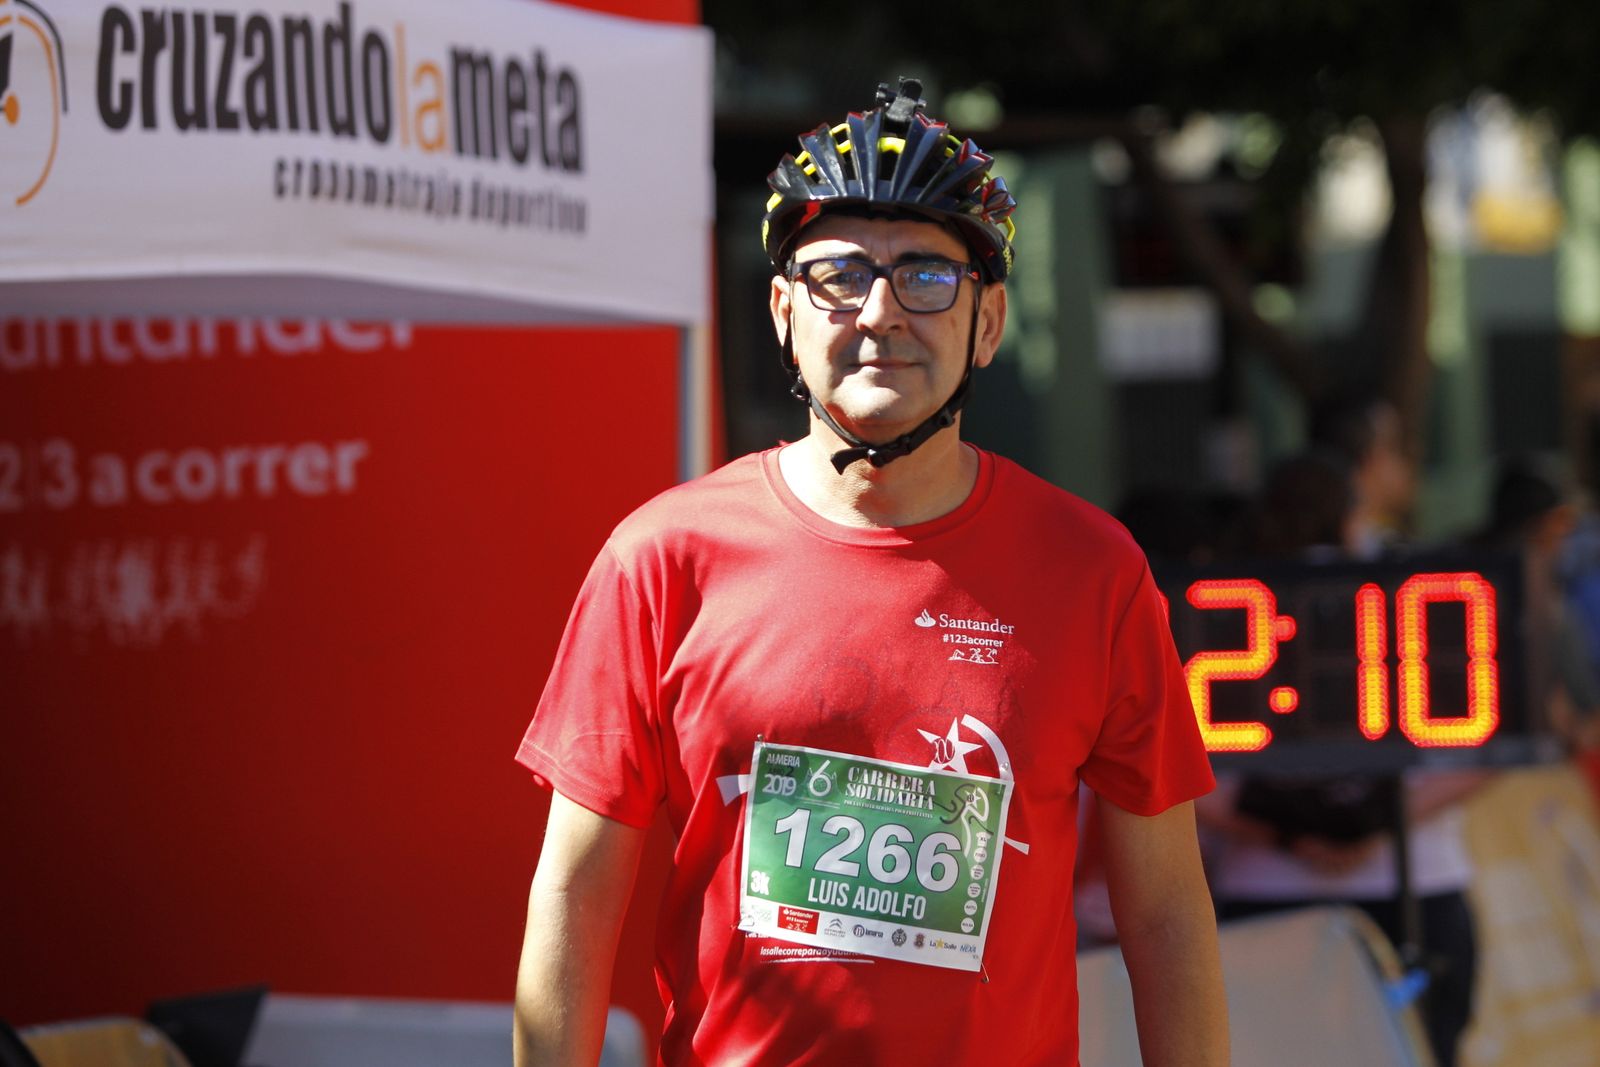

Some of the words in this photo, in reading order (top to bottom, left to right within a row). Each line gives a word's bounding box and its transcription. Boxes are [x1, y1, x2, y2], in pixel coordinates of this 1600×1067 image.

[136, 440, 366, 502] correr
[939, 613, 1015, 635] Santander
[942, 634, 1004, 648] #123acorrer
[1160, 572, 1498, 751] 2:10
[762, 773, 797, 796] 2019
[848, 766, 936, 796] CARRERA
[845, 783, 933, 810] SOLIDARIA
[775, 808, 962, 893] 1266
[807, 877, 850, 908] LUIS
[852, 886, 927, 921] ADOLFO
